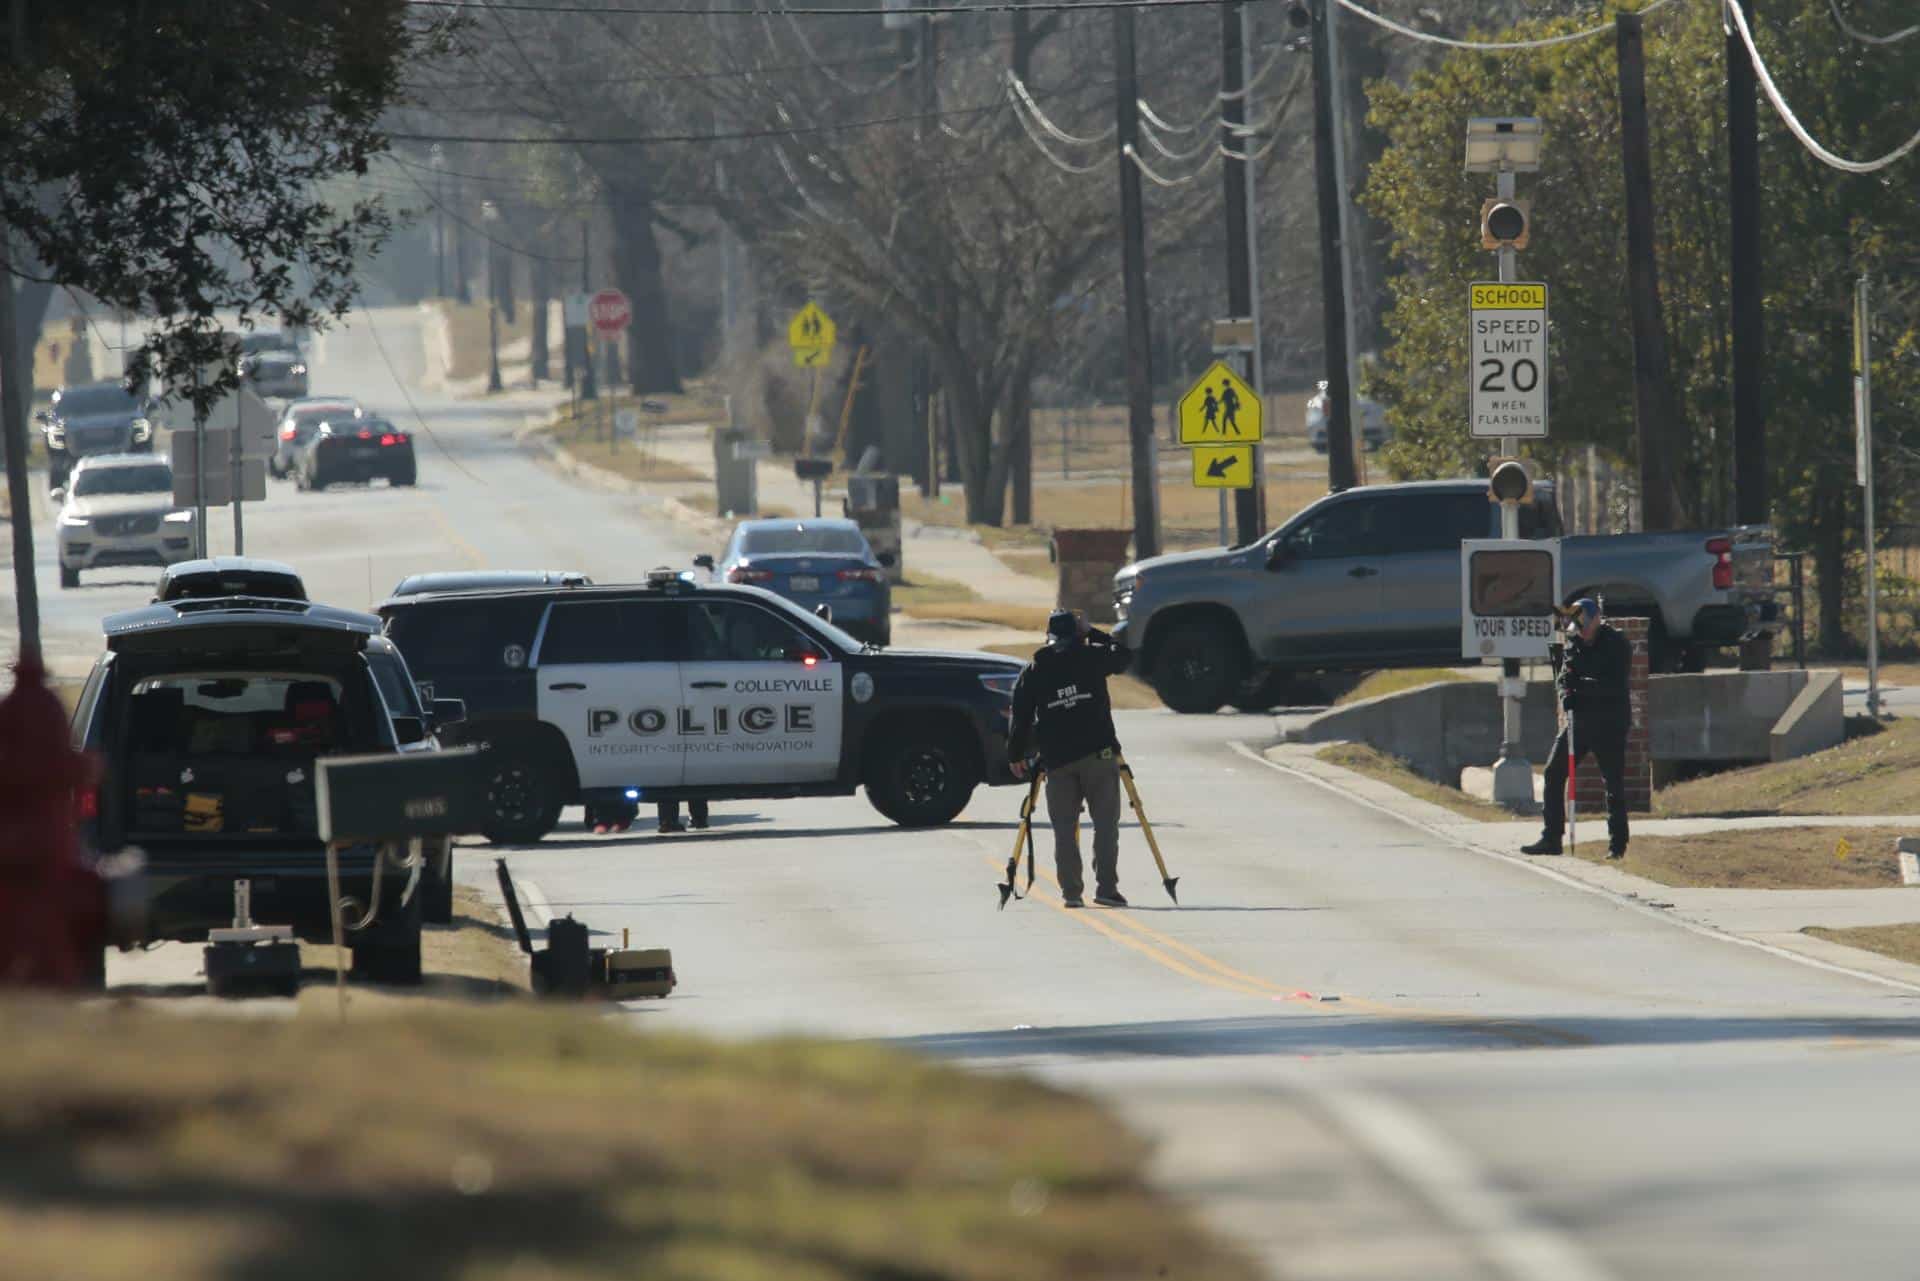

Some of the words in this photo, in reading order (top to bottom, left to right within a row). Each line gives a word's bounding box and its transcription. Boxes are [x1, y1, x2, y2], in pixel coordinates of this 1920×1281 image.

[1474, 289, 1543, 305] SCHOOL
[1477, 319, 1540, 335] SPEED
[1483, 339, 1533, 354] LIMIT
[1479, 358, 1539, 393] 20
[1491, 401, 1527, 410] WHEN
[1478, 415, 1541, 425] FLASHING
[1473, 618, 1506, 638] YOUR
[1511, 618, 1552, 638] SPEED
[734, 678, 833, 693] COLLEYVILLE
[1057, 684, 1077, 699] FBI
[587, 703, 818, 738] POLICE
